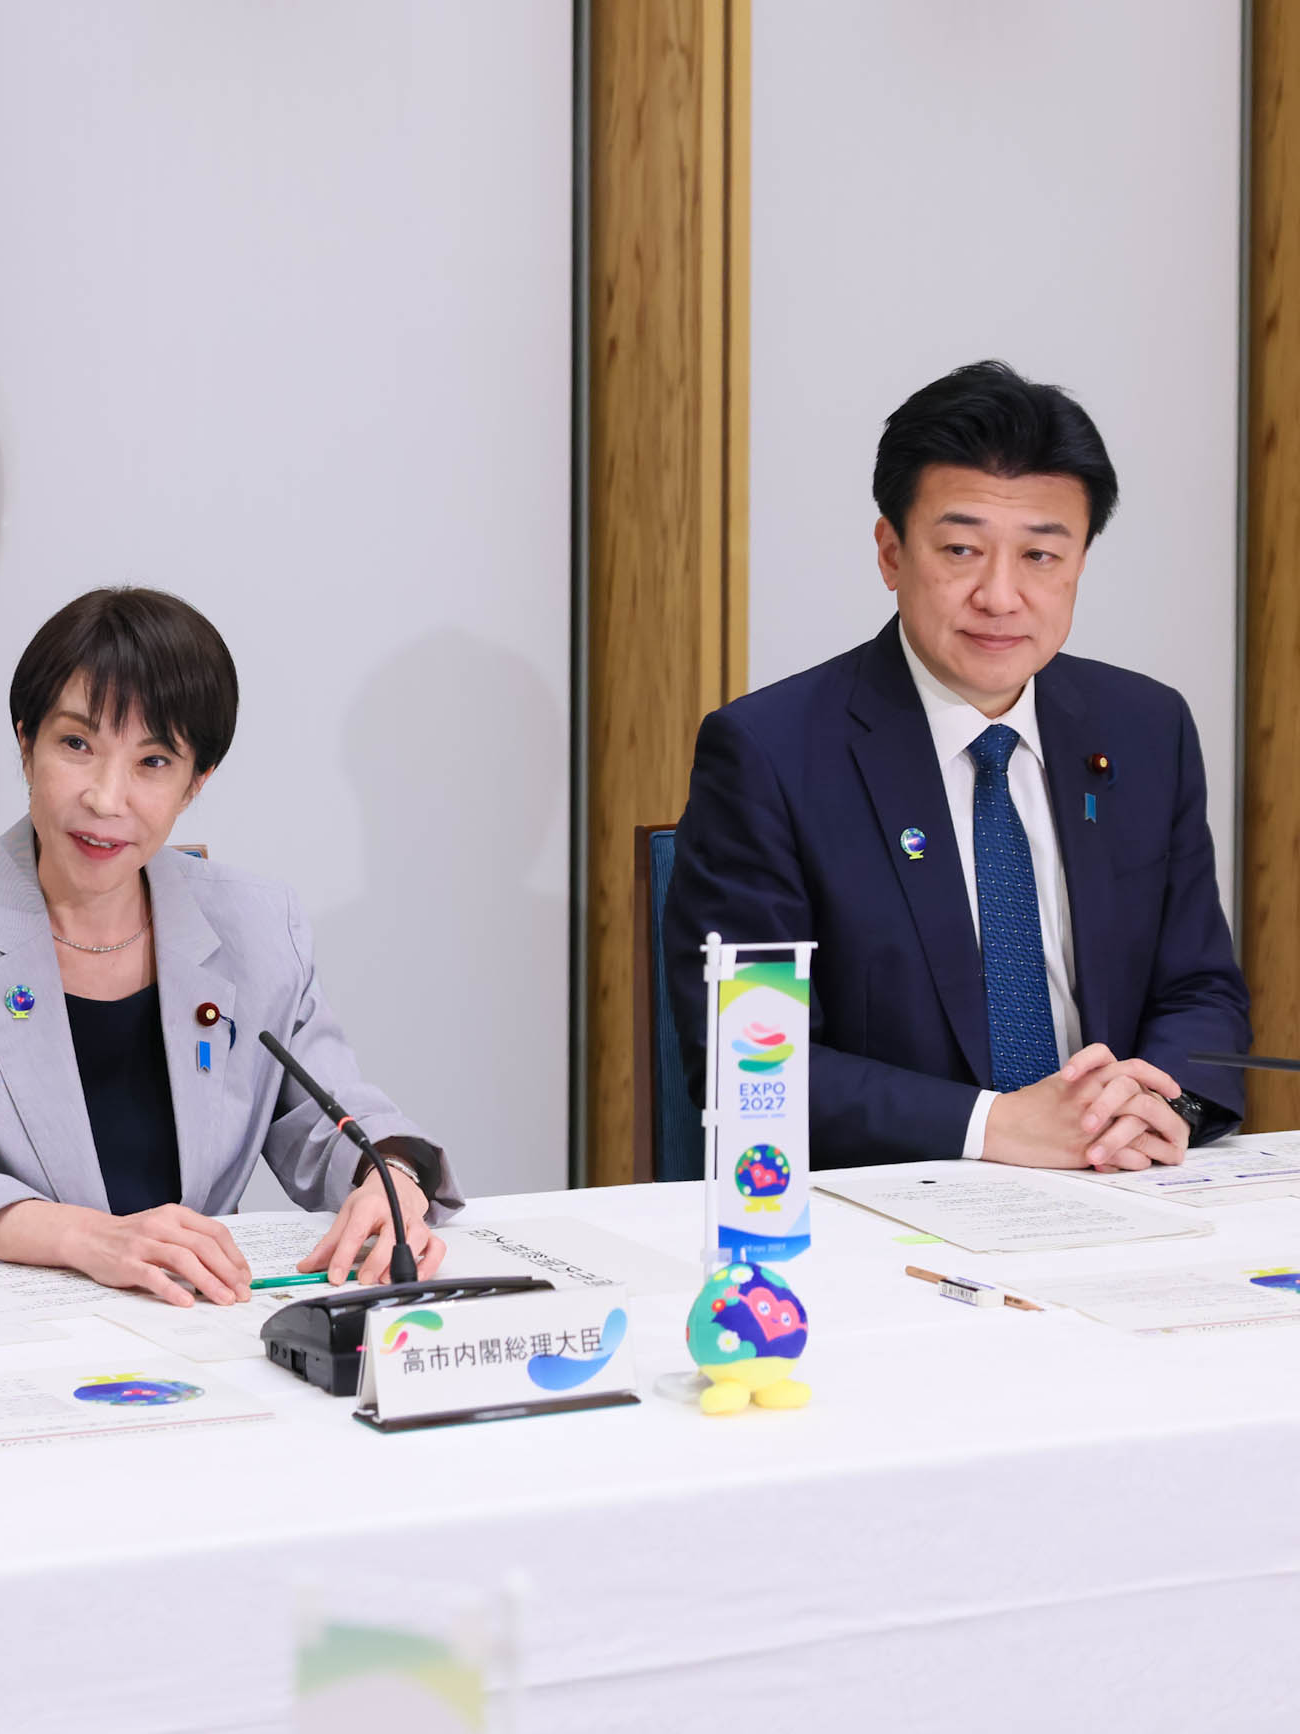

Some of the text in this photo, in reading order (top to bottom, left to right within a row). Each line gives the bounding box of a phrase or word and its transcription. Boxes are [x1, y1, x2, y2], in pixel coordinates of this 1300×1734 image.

[740, 1081, 786, 1096] EXPO
[740, 1096, 786, 1111] 2027
[402, 1327, 604, 1375] 高市内閣総理大臣
